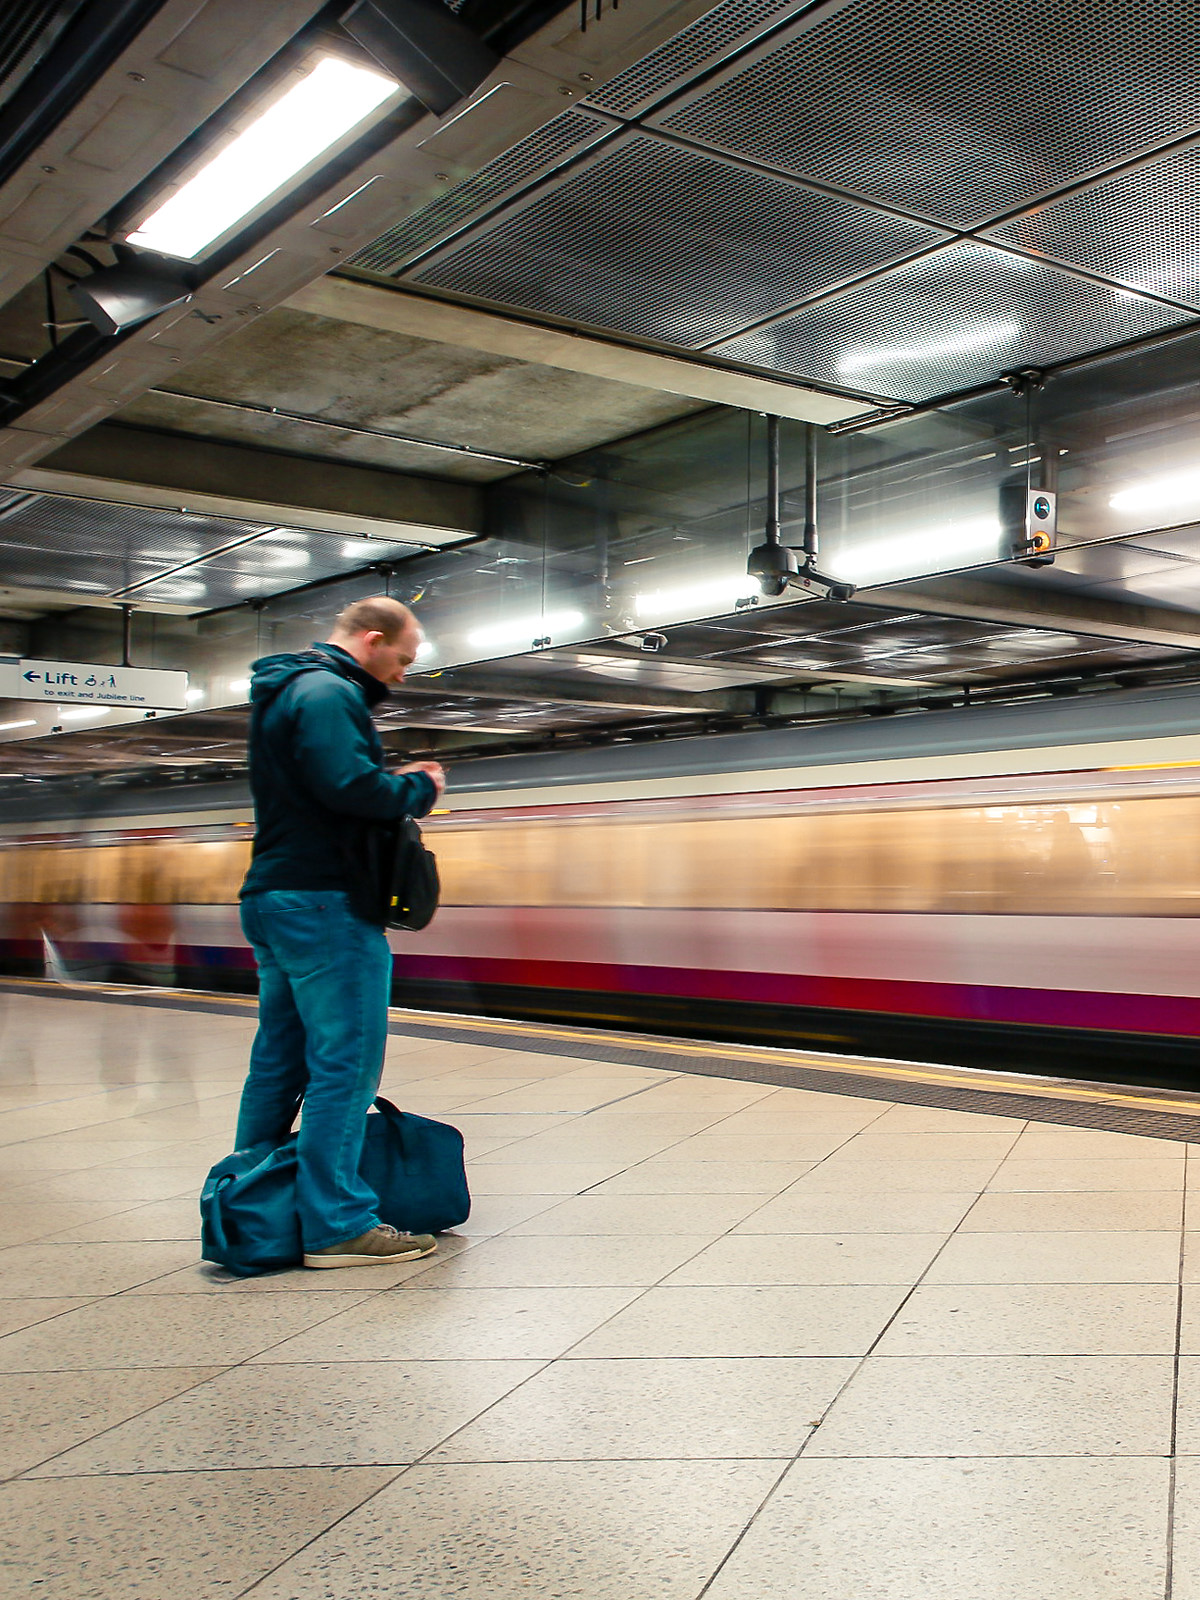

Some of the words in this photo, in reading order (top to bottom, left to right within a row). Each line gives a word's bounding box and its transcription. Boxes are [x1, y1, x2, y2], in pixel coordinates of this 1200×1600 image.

[45, 671, 78, 686] Lift
[57, 690, 75, 698] exit
[97, 692, 127, 701] Jubilee
[129, 694, 145, 702] line
